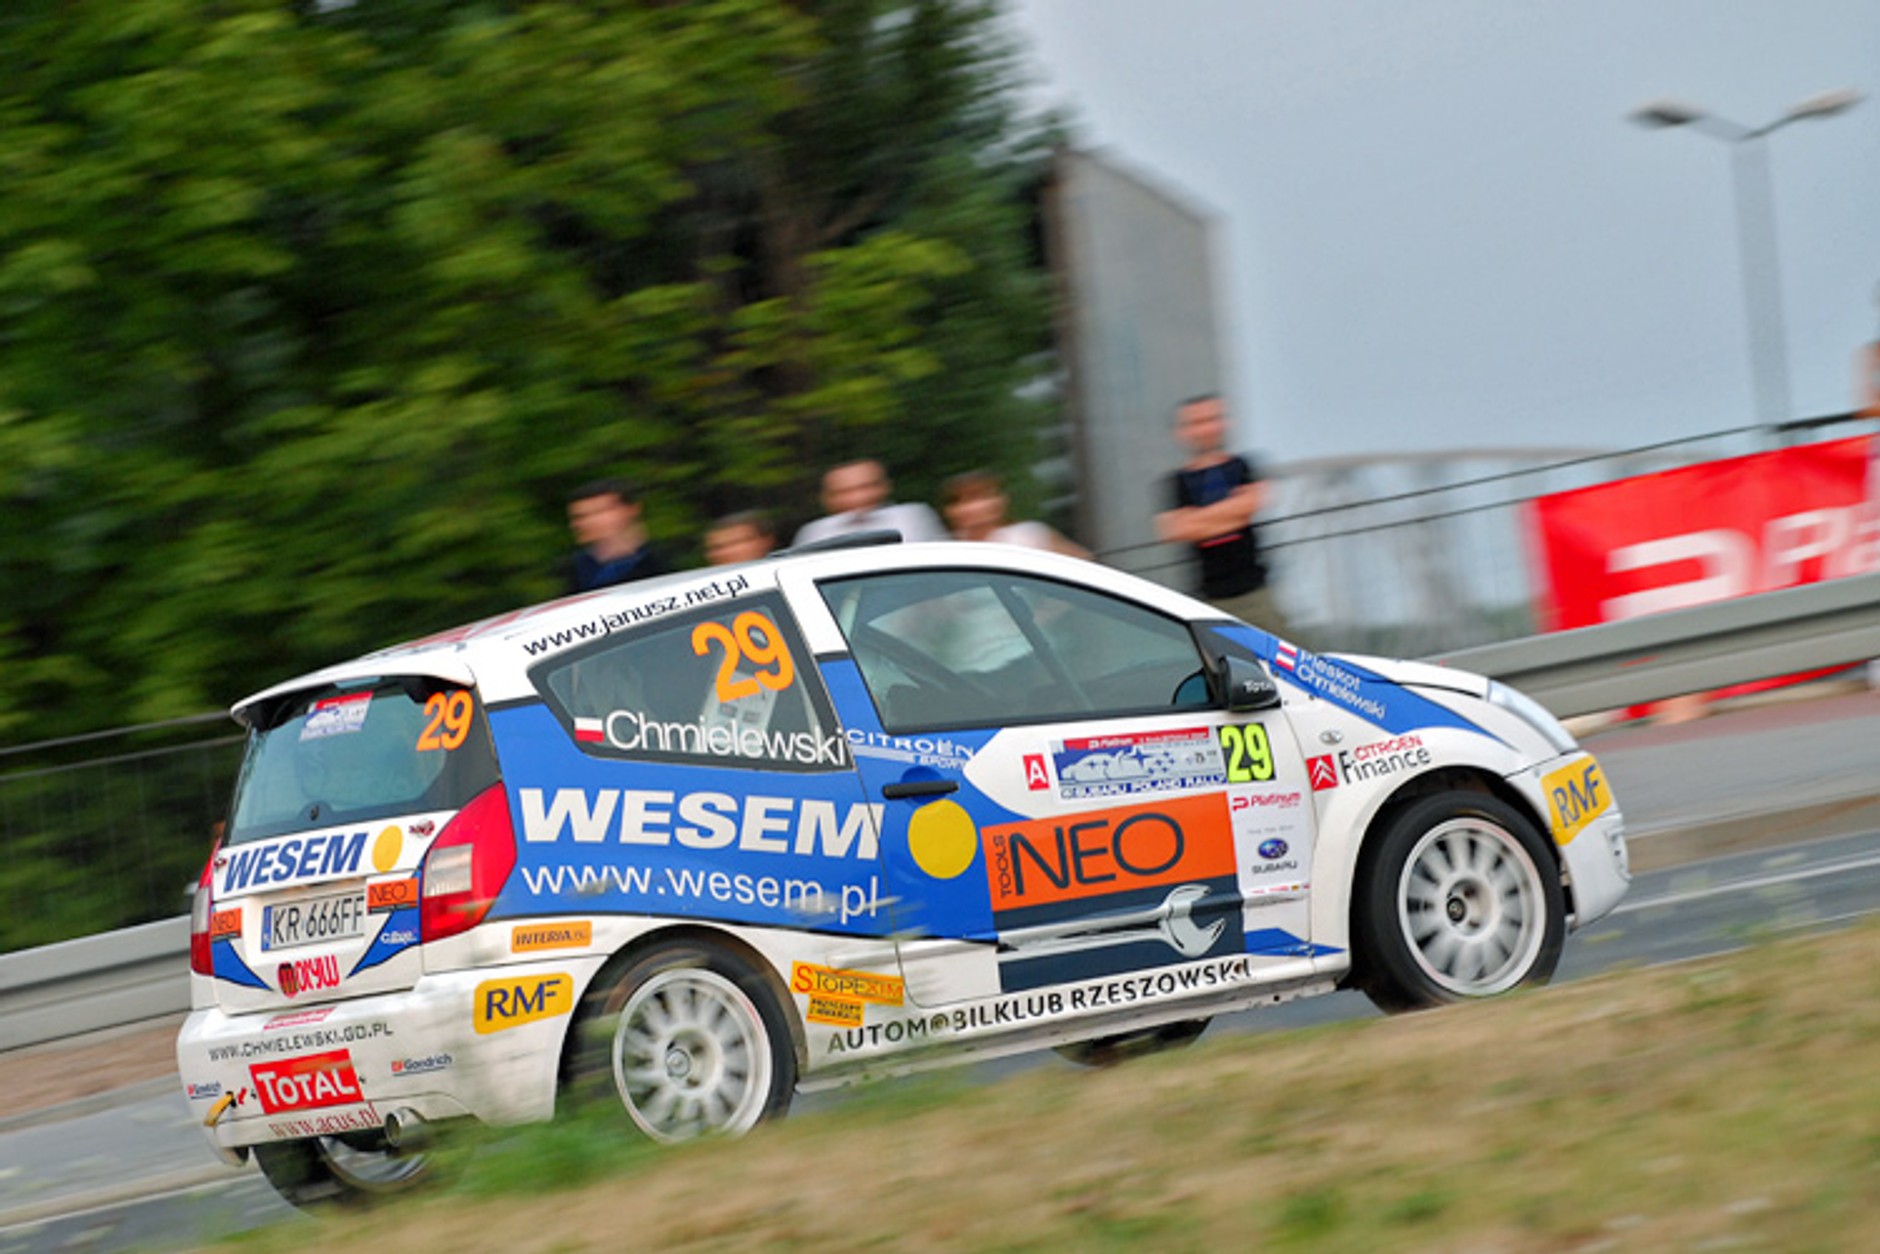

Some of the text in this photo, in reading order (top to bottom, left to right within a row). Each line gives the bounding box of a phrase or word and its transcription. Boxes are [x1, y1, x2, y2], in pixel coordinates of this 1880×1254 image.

[522, 574, 750, 656] www.janusz.net.pl
[691, 611, 795, 703] 29
[416, 689, 475, 752] 29
[605, 710, 846, 765] Chmielewski
[1027, 760, 1048, 785] A
[1220, 723, 1275, 783] 29
[1338, 748, 1432, 785] Finance
[519, 787, 885, 860] WESEM
[1551, 763, 1600, 829] RMF
[223, 832, 369, 893] WESEM
[993, 834, 1011, 899] TOOLS
[1009, 813, 1185, 896] NEO
[1251, 860, 1298, 875] SUBARU
[273, 905, 300, 944] KR
[305, 895, 365, 938] 666FF
[369, 882, 408, 902] NEO
[522, 865, 879, 925] www.wesem.pl
[485, 979, 563, 1021] RMF
[827, 957, 1252, 1054] AUTOMOBILKLUB RZESZOWSKI
[255, 1067, 355, 1108] TOTAL
